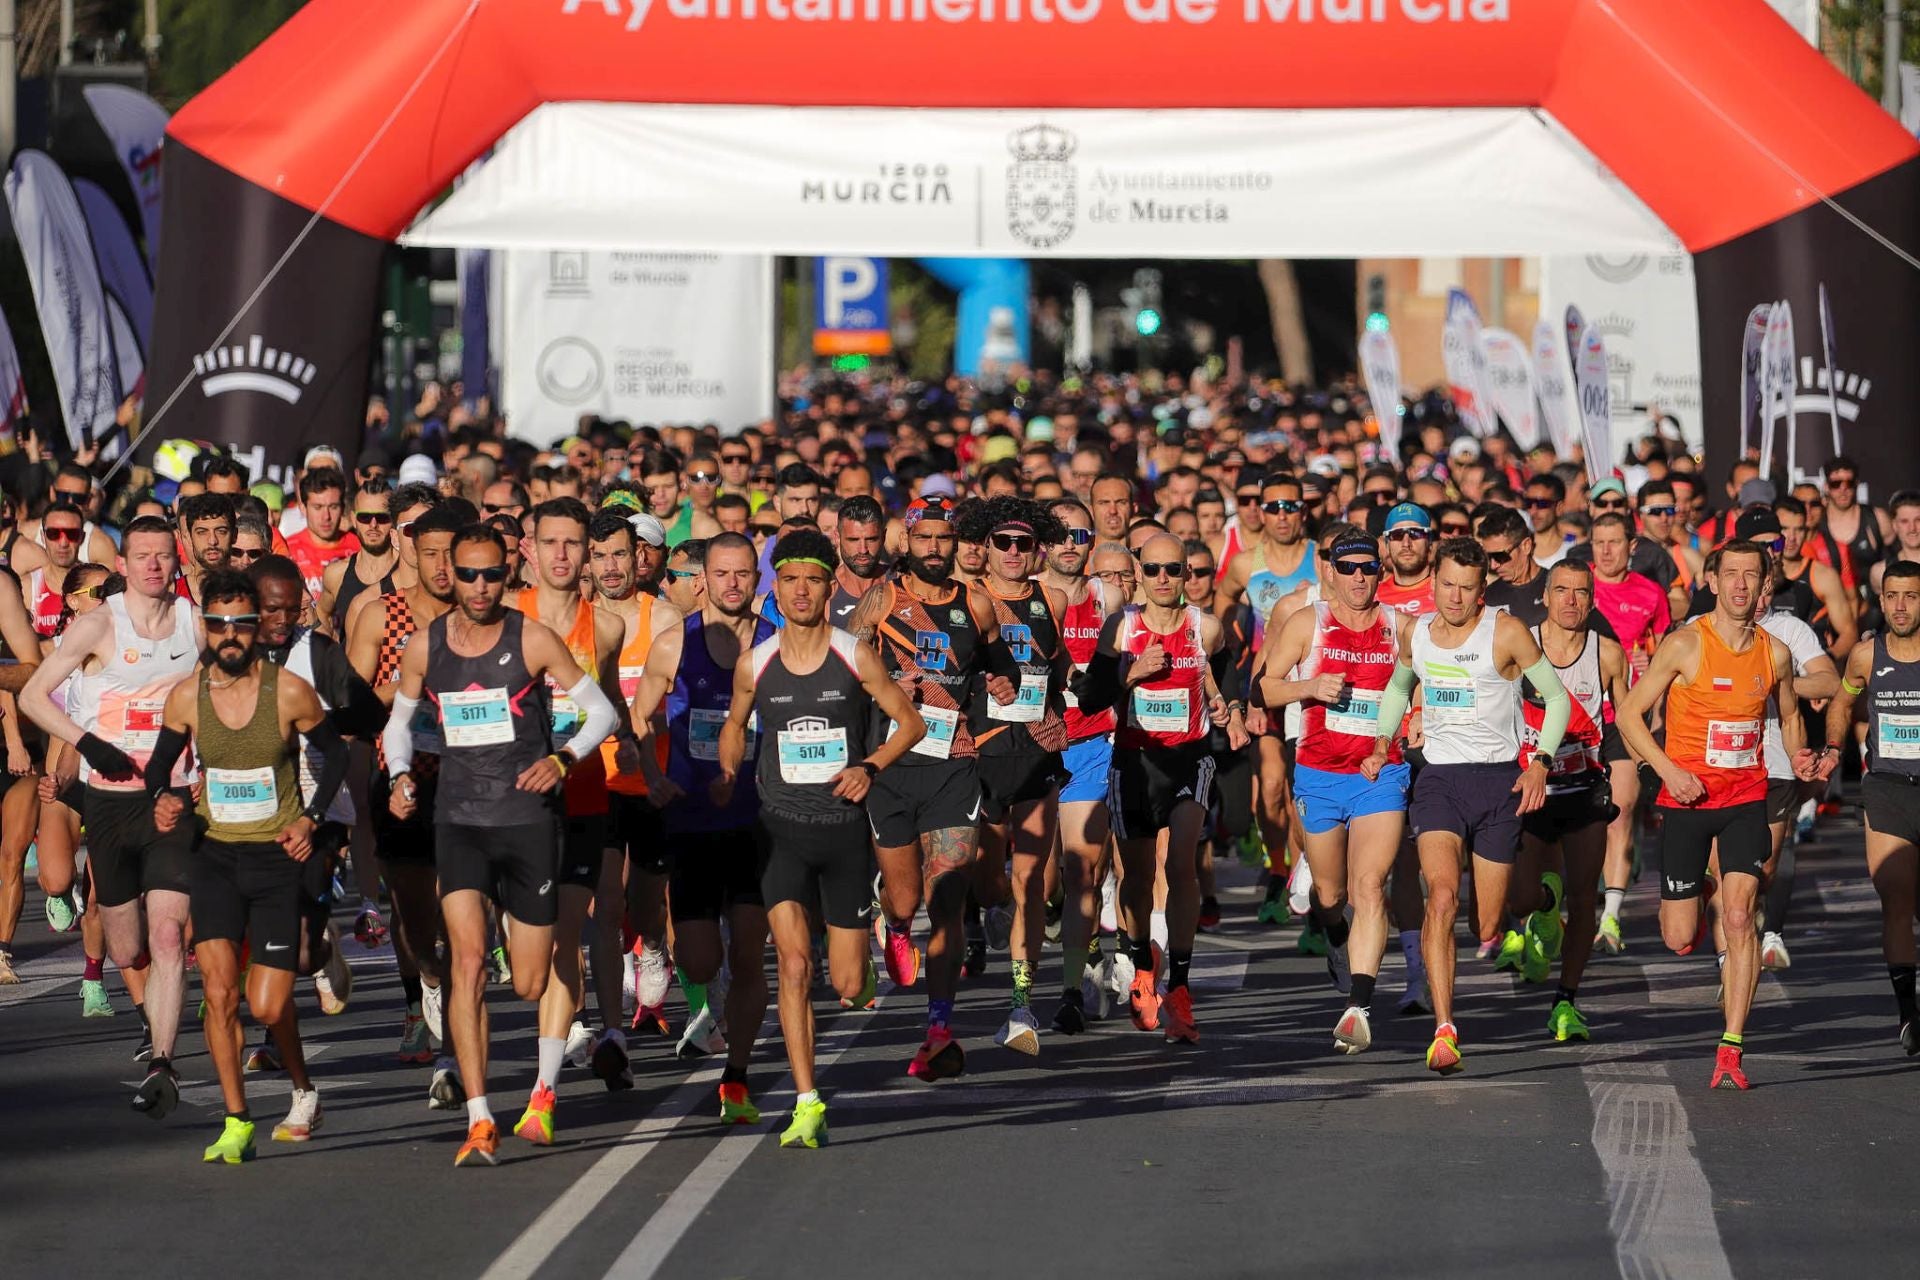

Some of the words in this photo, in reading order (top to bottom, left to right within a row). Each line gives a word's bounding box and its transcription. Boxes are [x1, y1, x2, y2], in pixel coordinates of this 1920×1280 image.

[561, 0, 1099, 31] yunameno
[1089, 168, 1274, 194] Ayuntamiento
[801, 181, 952, 202] MURCIA
[1089, 201, 1118, 222] de
[1128, 200, 1230, 222] Murcia
[823, 258, 878, 328] P
[1322, 647, 1363, 664] PUERTAS
[1364, 652, 1394, 664] LORCA
[1436, 690, 1461, 702] 2007
[461, 706, 488, 720] 5171
[1146, 702, 1172, 714] 2013
[1895, 728, 1919, 739] 2019
[1731, 735, 1744, 747] 30
[800, 745, 826, 759] 5174
[223, 785, 256, 799] 2005
